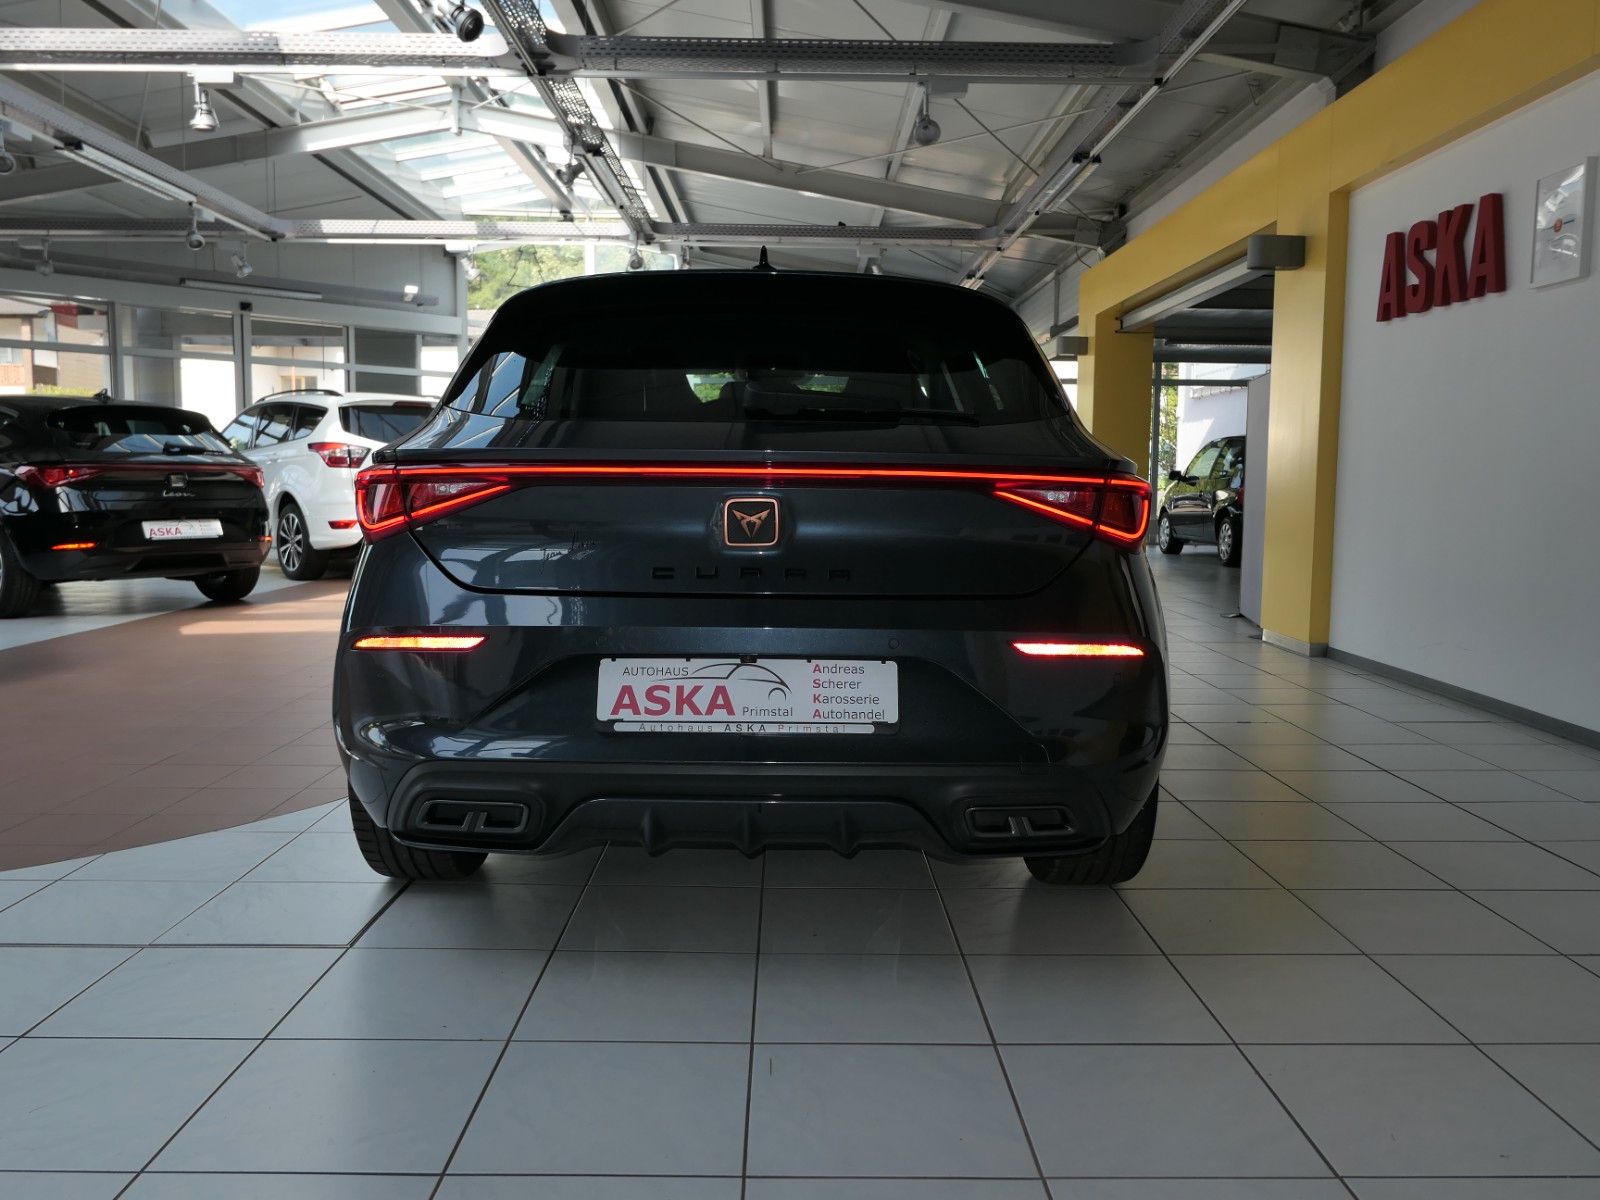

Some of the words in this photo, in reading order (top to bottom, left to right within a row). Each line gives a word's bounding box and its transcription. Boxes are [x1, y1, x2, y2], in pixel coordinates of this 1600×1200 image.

[1376, 192, 1507, 322] ASKA
[149, 526, 183, 537] ASKA
[651, 566, 852, 581] CUPRA
[622, 666, 689, 677] AUTOHAUS
[812, 663, 865, 675] Andreas
[812, 678, 862, 690] Scherer
[610, 684, 736, 717] ASKA
[812, 693, 881, 705] Karosserie
[742, 706, 794, 718] Primstal
[812, 708, 886, 721] Autohandel
[638, 722, 714, 733] Autohaus
[723, 723, 767, 733] ASKA
[777, 724, 847, 734] Primstal
